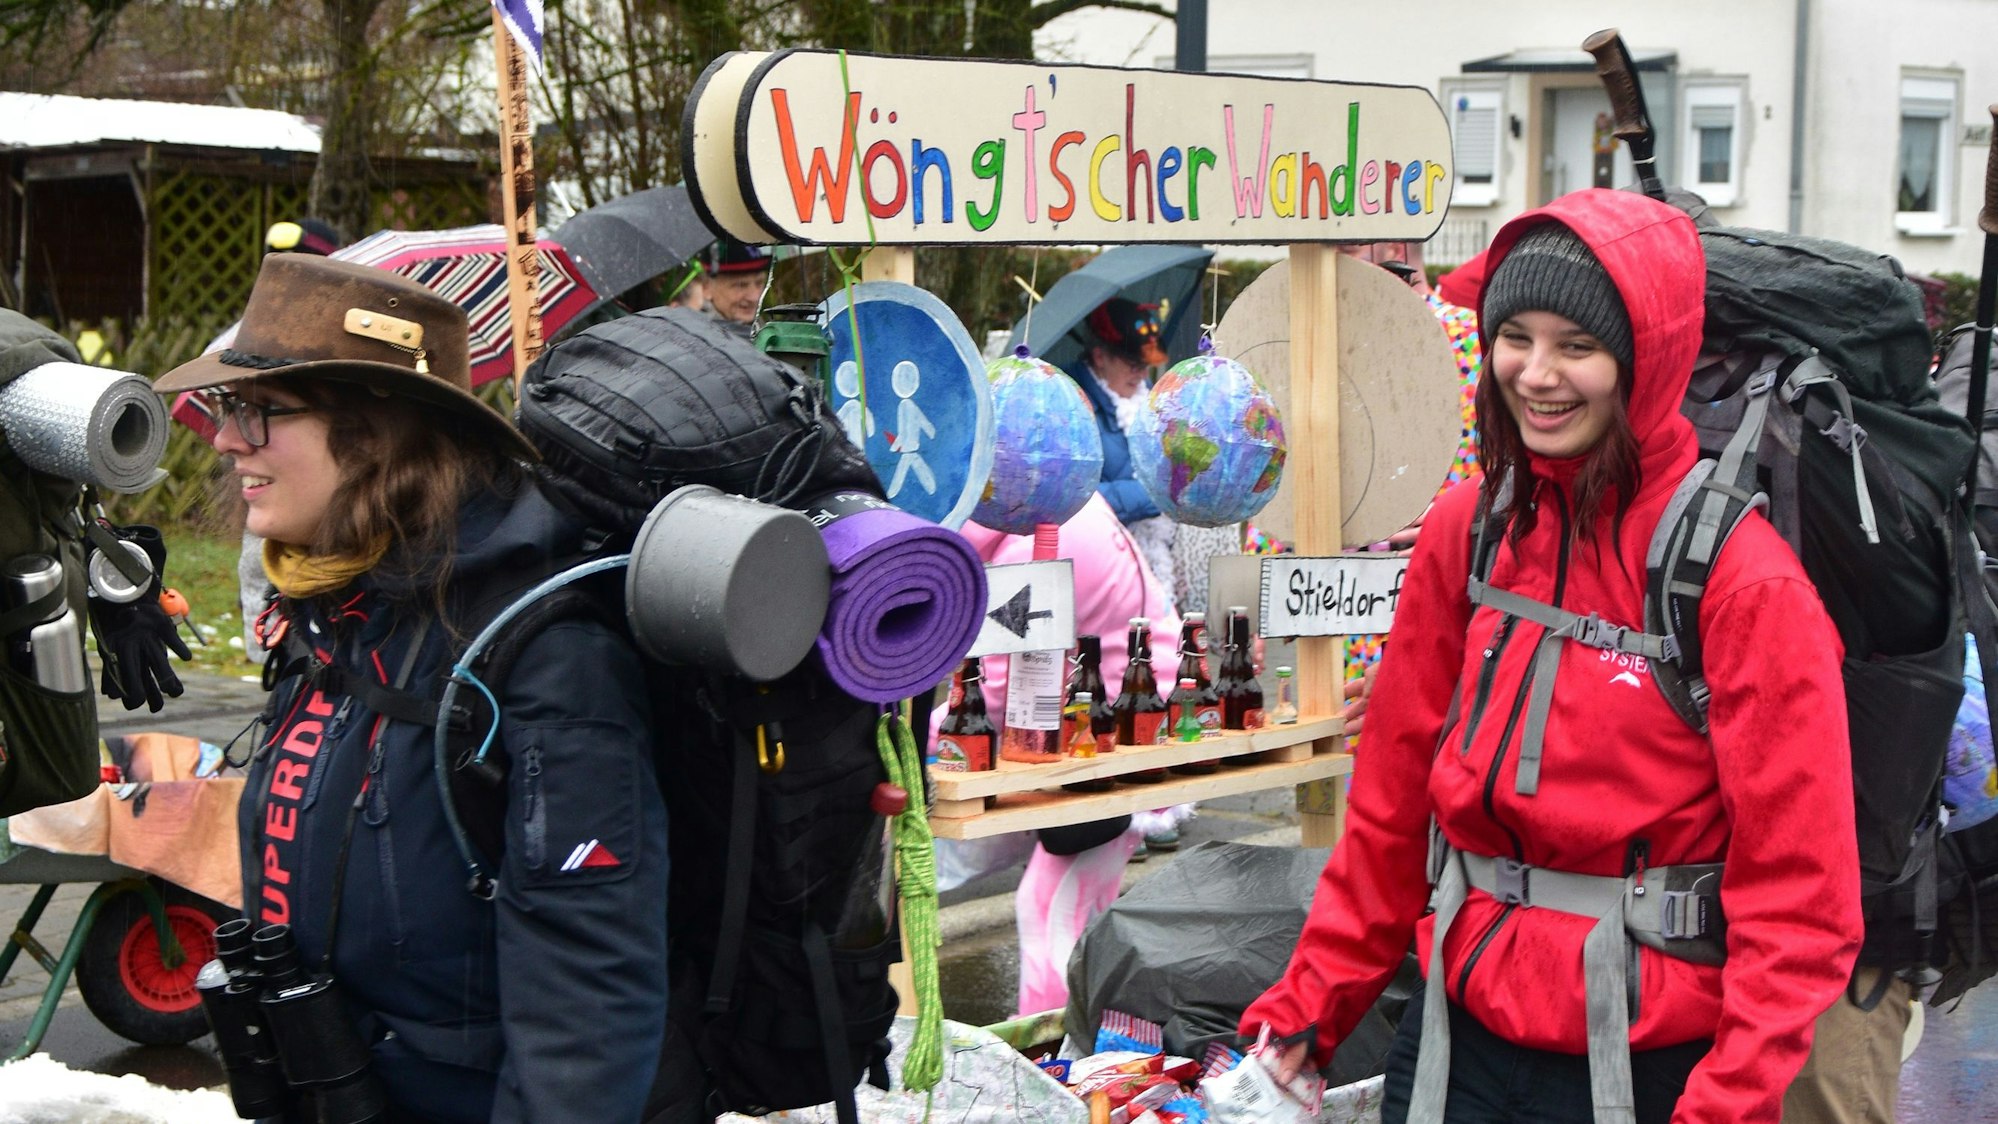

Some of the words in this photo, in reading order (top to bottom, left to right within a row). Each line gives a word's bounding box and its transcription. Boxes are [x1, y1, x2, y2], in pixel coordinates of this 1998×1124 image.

[1223, 101, 1445, 219] Wanderer
[1286, 568, 1407, 617] Stieldorf
[261, 647, 334, 925] UPERD
